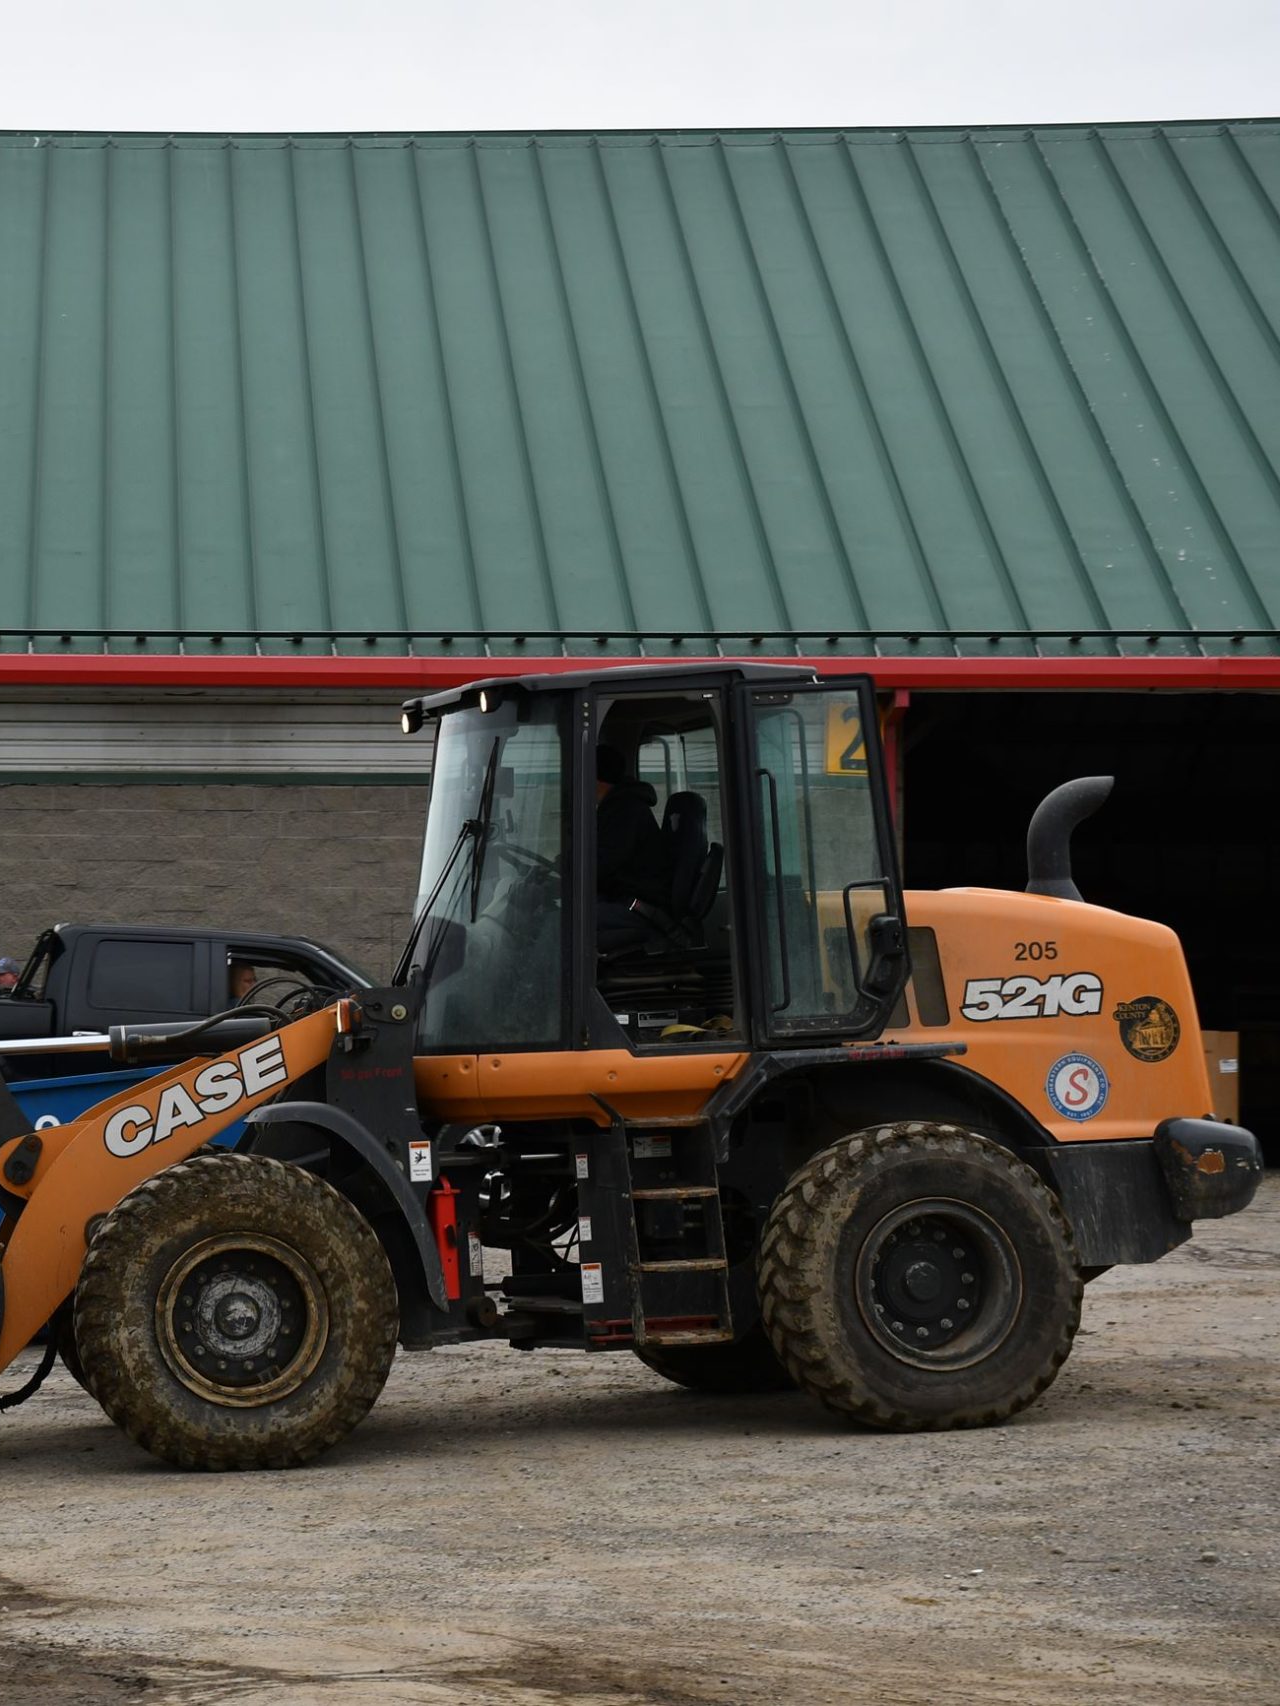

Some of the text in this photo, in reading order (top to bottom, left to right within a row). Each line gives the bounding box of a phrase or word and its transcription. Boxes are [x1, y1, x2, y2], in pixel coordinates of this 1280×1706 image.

[1014, 941, 1058, 961] 205
[959, 971, 1104, 1023] 521G
[1113, 1011, 1146, 1020] COUNTY
[104, 1034, 289, 1159] CASE
[1065, 1068, 1089, 1106] S
